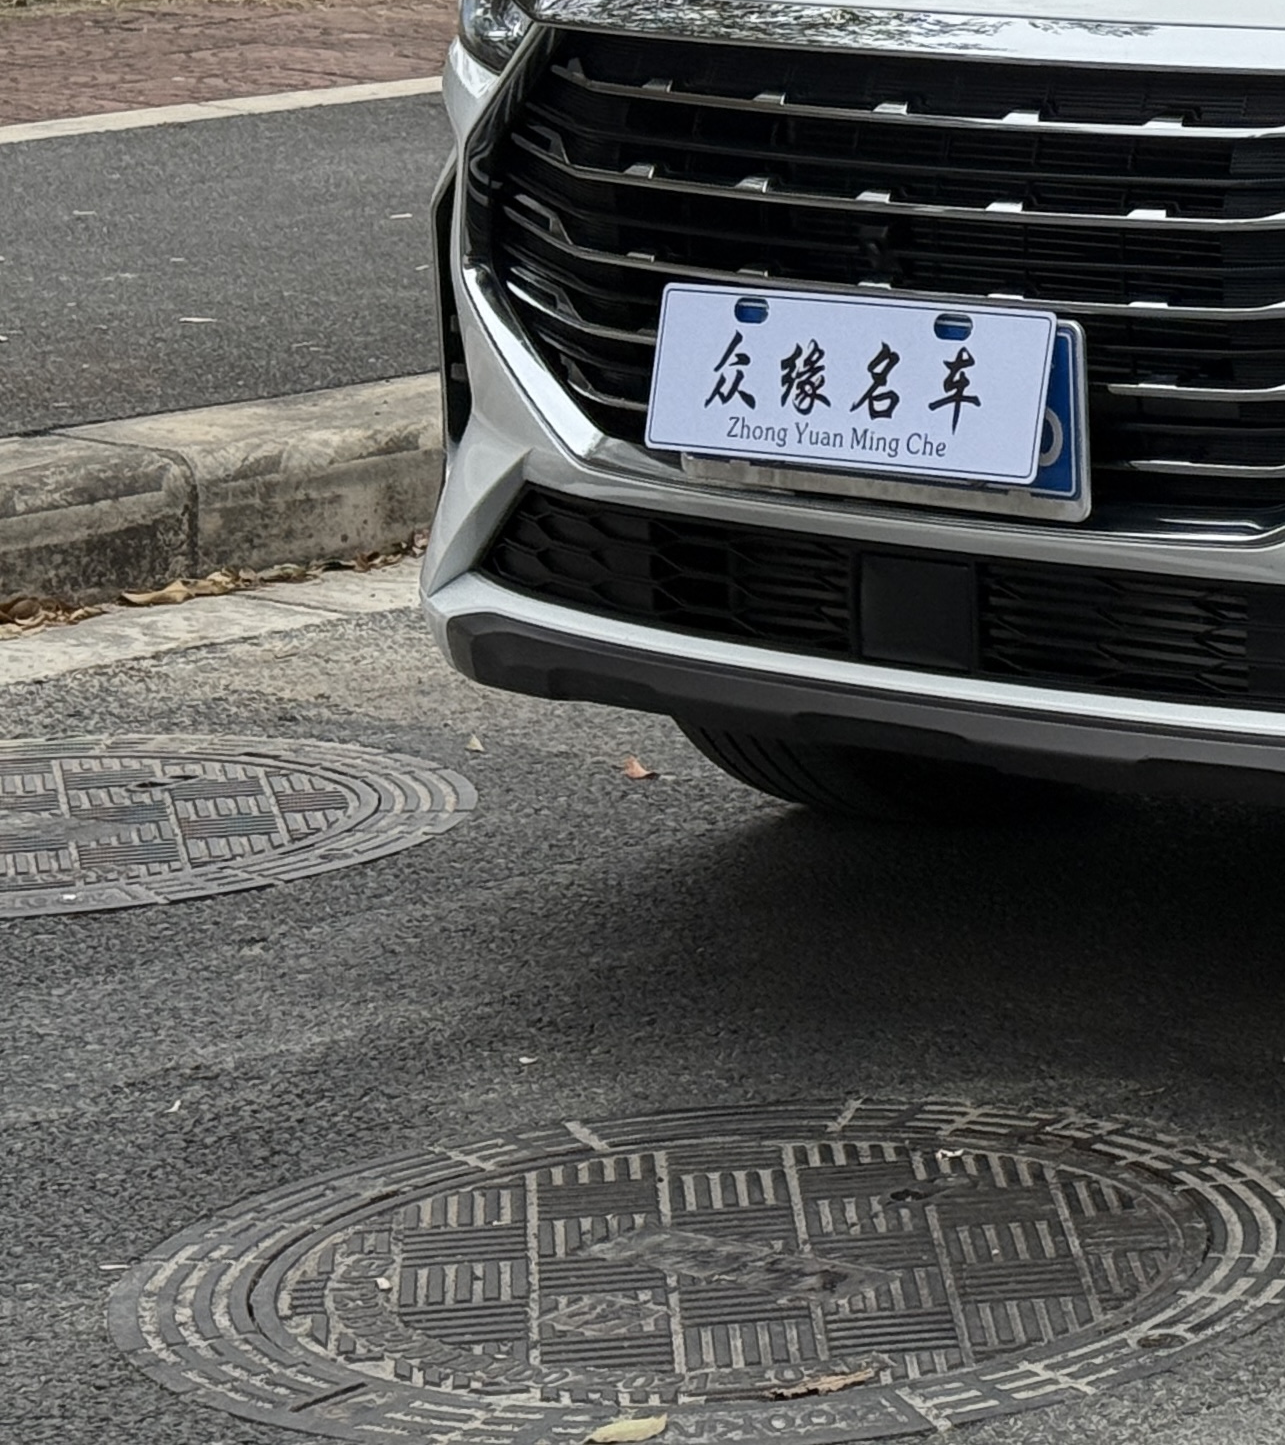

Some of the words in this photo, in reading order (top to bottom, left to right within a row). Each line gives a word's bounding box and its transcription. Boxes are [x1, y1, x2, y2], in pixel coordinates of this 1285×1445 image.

[704, 329, 982, 435] 众缘名车
[727, 416, 788, 448] Zhong
[795, 422, 844, 448] Yuan
[850, 427, 901, 457] Ming
[906, 432, 947, 457] Che
